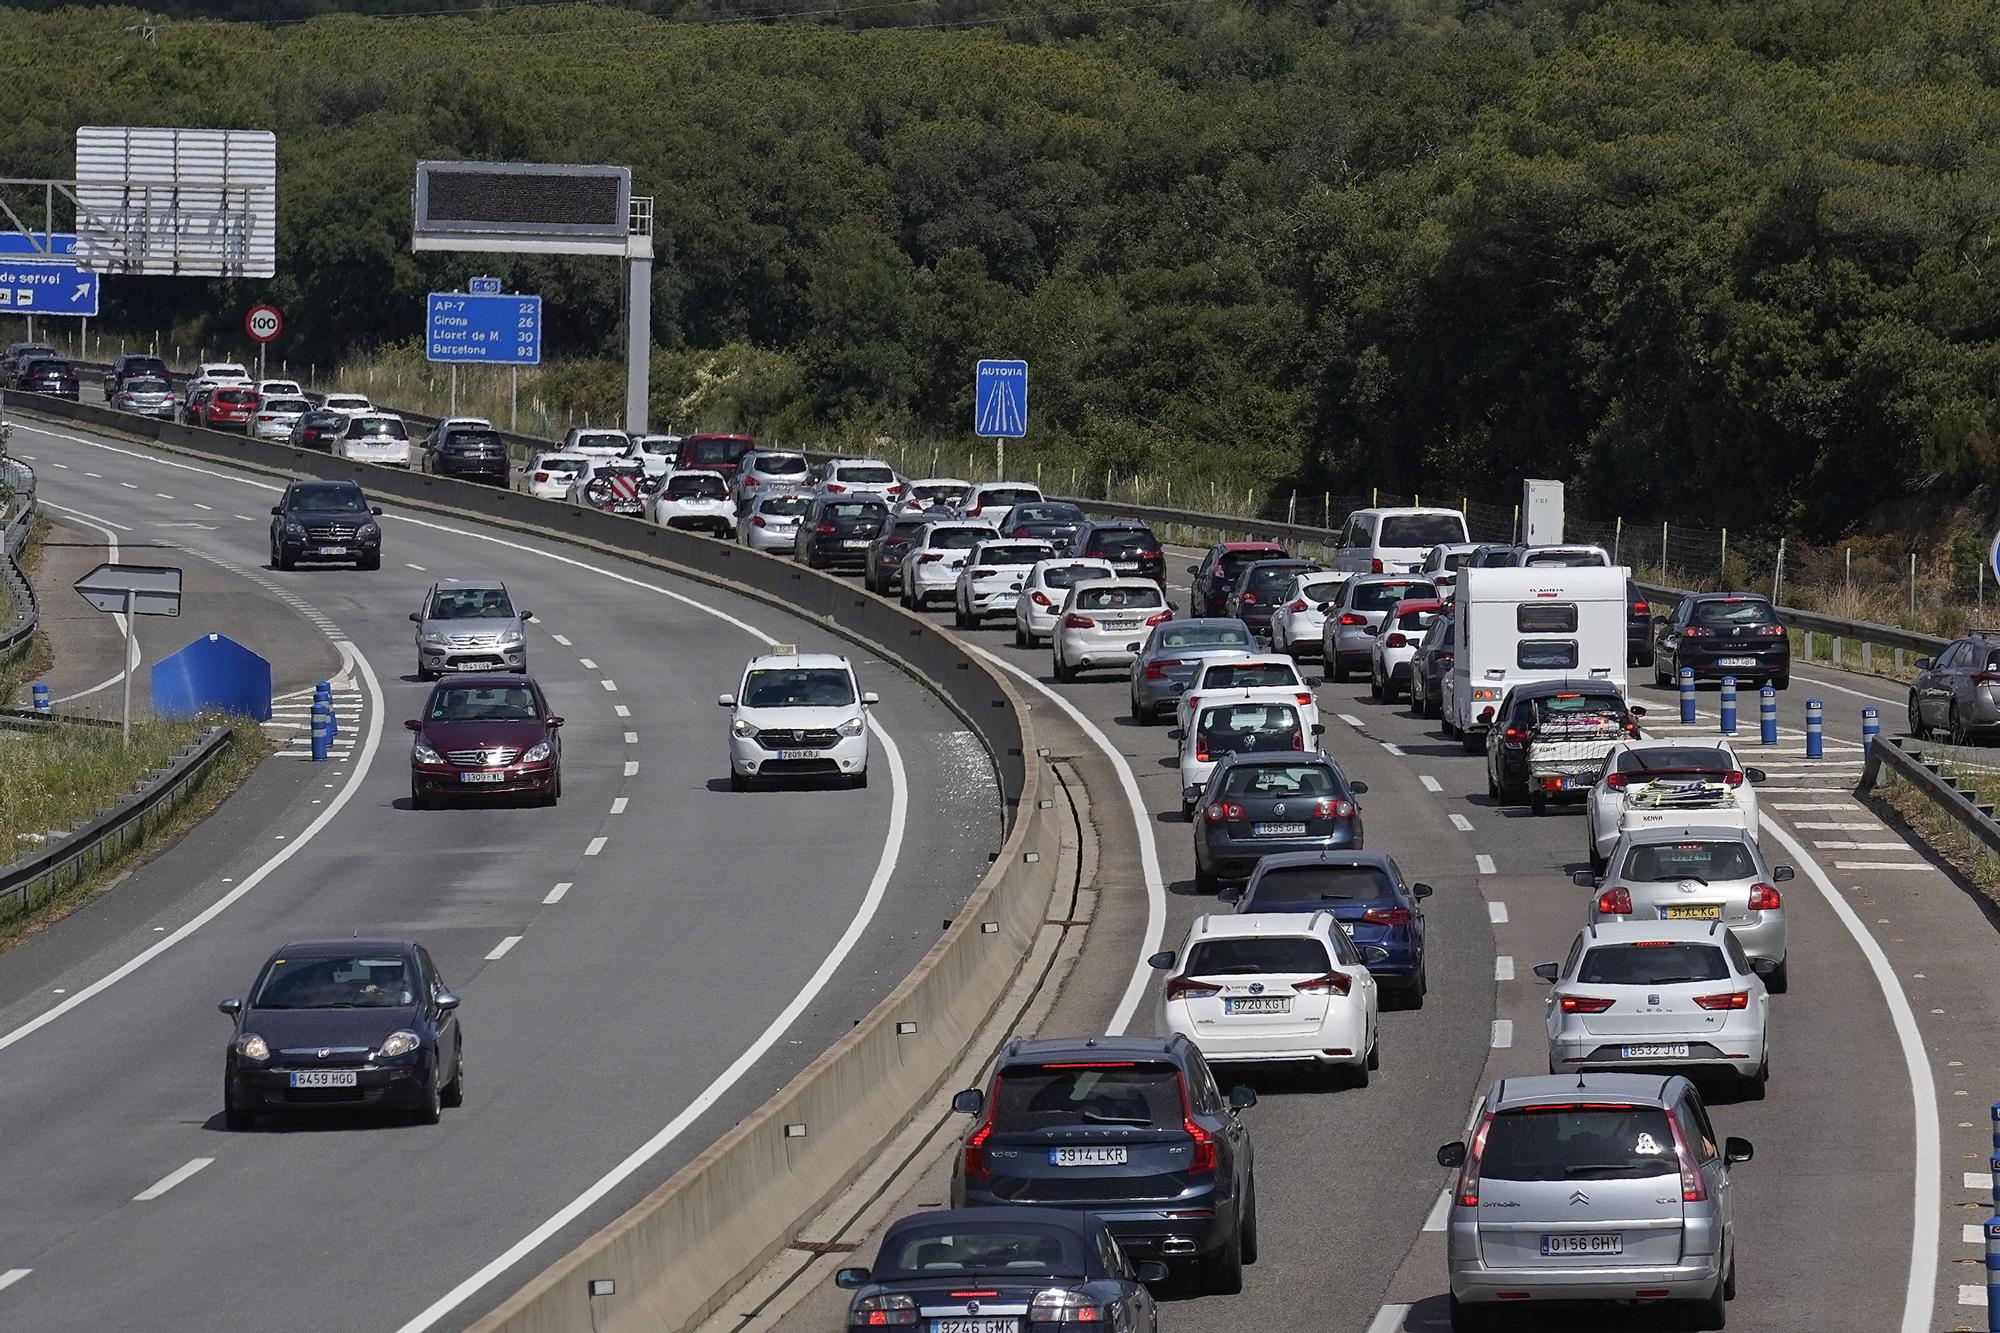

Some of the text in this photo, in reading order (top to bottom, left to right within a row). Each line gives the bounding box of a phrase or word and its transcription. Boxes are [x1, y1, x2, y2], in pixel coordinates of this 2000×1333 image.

[1, 272, 60, 285] de servei
[434, 301, 534, 314] AP-7 22
[252, 317, 276, 330] 100
[434, 315, 534, 328] Girona 26
[433, 329, 534, 343] Lloret de M. 30
[433, 344, 534, 357] Barcelona 93
[981, 367, 1023, 376] AUTOVIA
[783, 750, 819, 759] 7809 KRJ
[466, 772, 486, 781] 3309
[1262, 823, 1284, 833] 1895
[1234, 998, 1287, 1010] 9720 KGT
[1630, 1044, 1686, 1056] 8532 JYG
[299, 1073, 328, 1085] 6459
[1046, 1130, 1130, 1138] VOLVO
[1059, 1149, 1124, 1162] 3914 LKR
[1551, 1237, 1619, 1251] 0156 GHY
[941, 1321, 1014, 1333] 9246 GMK
